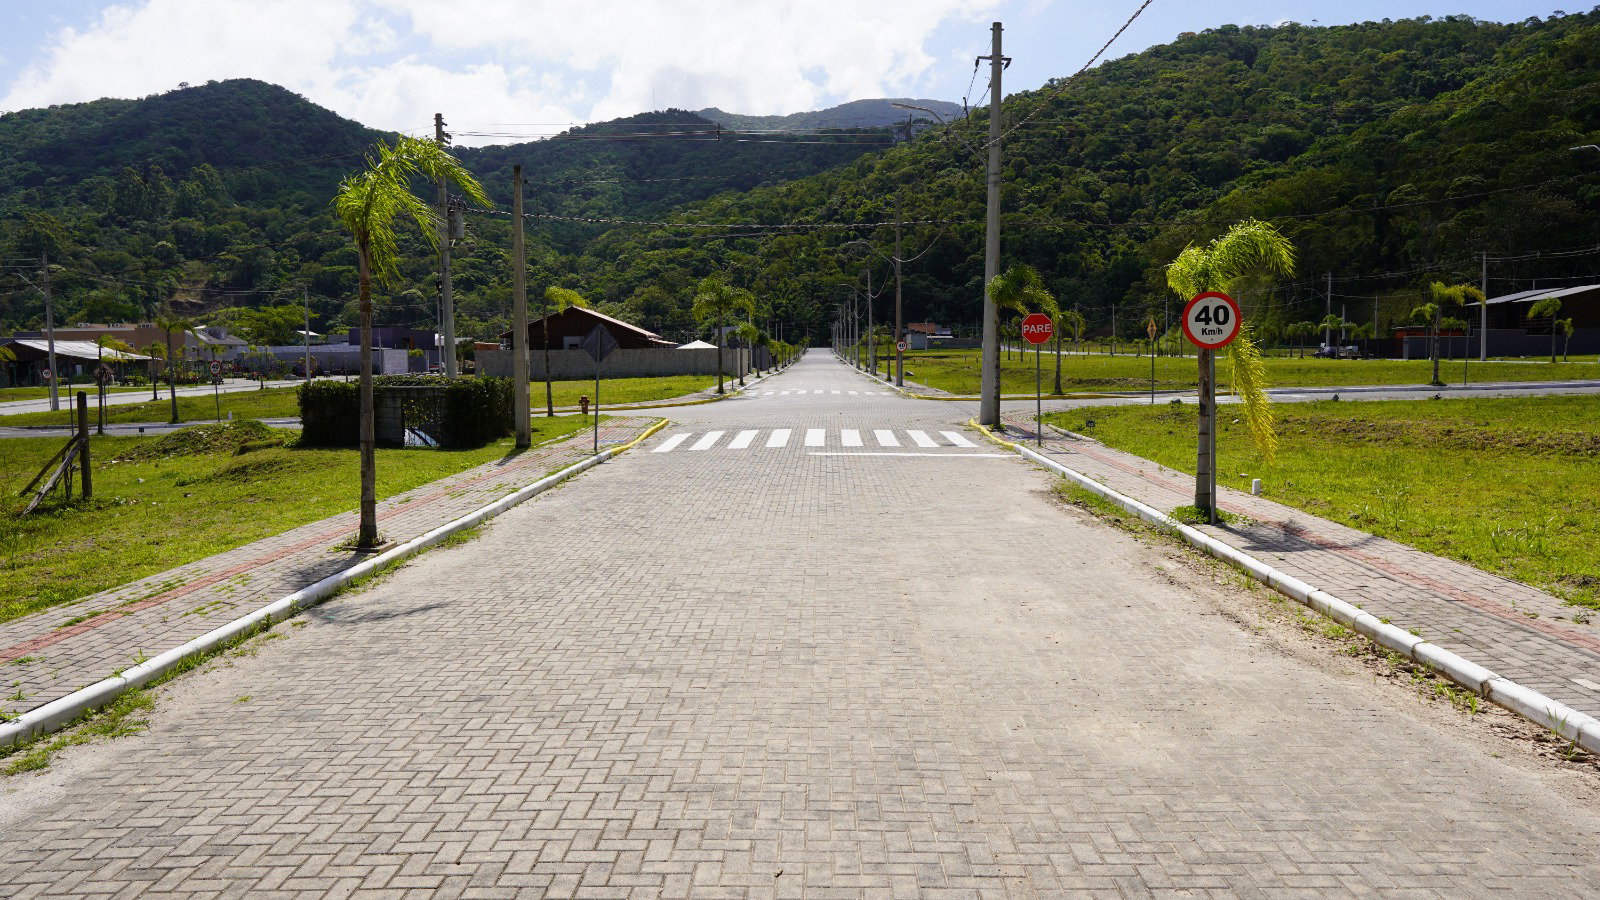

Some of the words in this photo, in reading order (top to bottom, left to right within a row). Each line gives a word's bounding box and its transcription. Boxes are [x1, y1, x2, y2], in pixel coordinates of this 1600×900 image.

[1194, 304, 1230, 326] 40
[1023, 323, 1051, 334] PARE
[1201, 327, 1223, 336] Km/h
